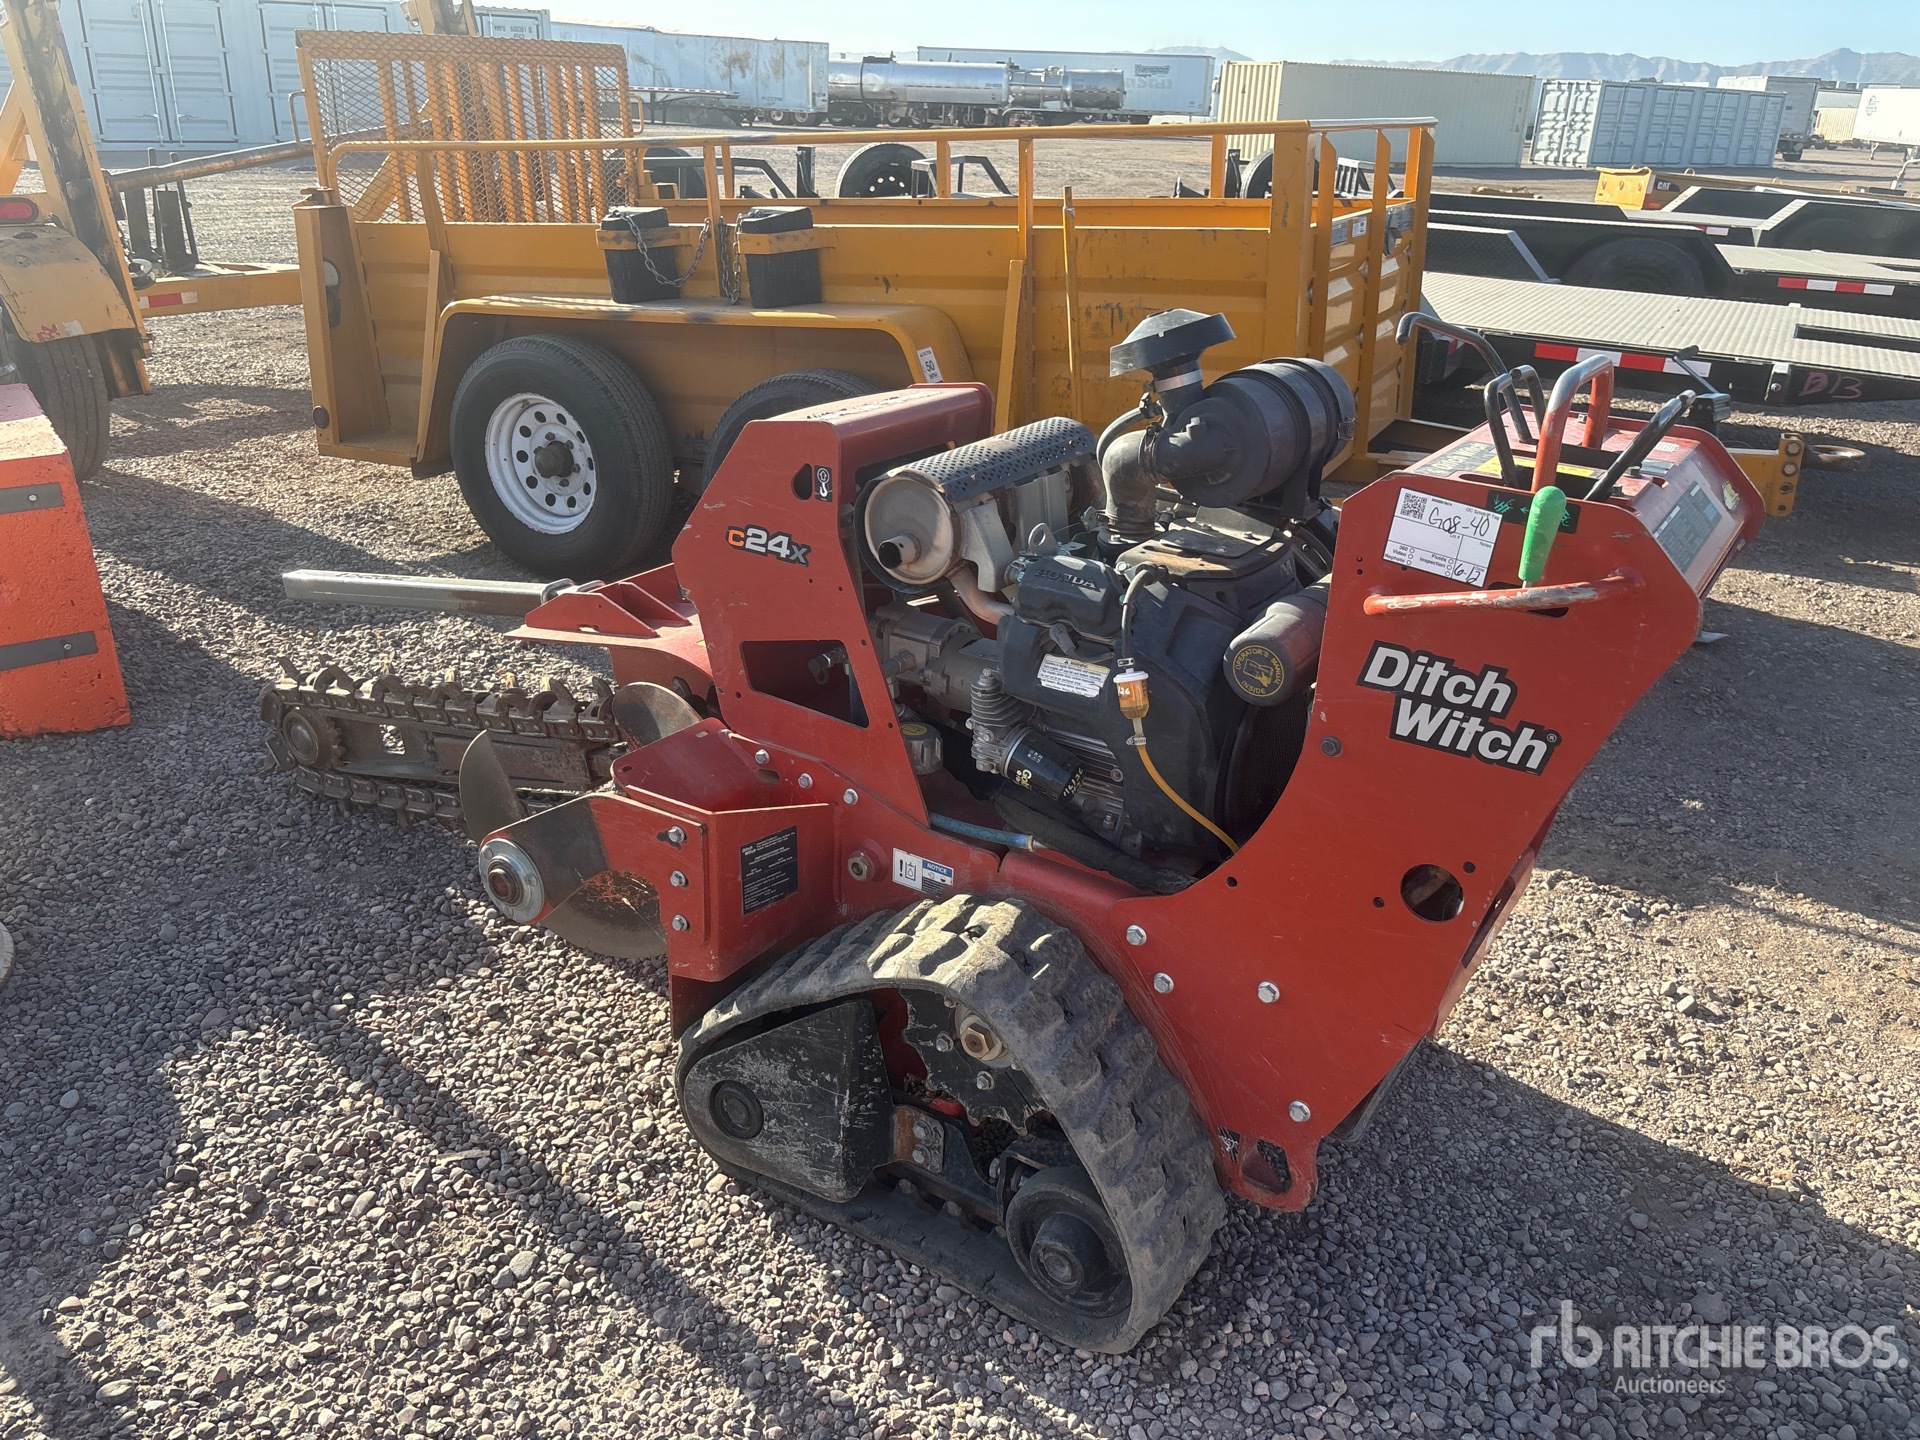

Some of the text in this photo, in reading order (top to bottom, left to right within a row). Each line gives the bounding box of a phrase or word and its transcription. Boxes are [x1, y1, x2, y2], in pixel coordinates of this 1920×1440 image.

[1656, 181, 1671, 190] CAT
[1392, 548, 1407, 557] Video
[1431, 554, 1447, 562] Fluids
[1419, 557, 1446, 568] Inspection
[1035, 570, 1101, 592] HONDA
[1235, 648, 1282, 685] OPERATOR'S MANUAL
[1363, 646, 1512, 713] Ditch
[1241, 680, 1266, 695] INSIDE
[926, 862, 948, 875] NOTICE
